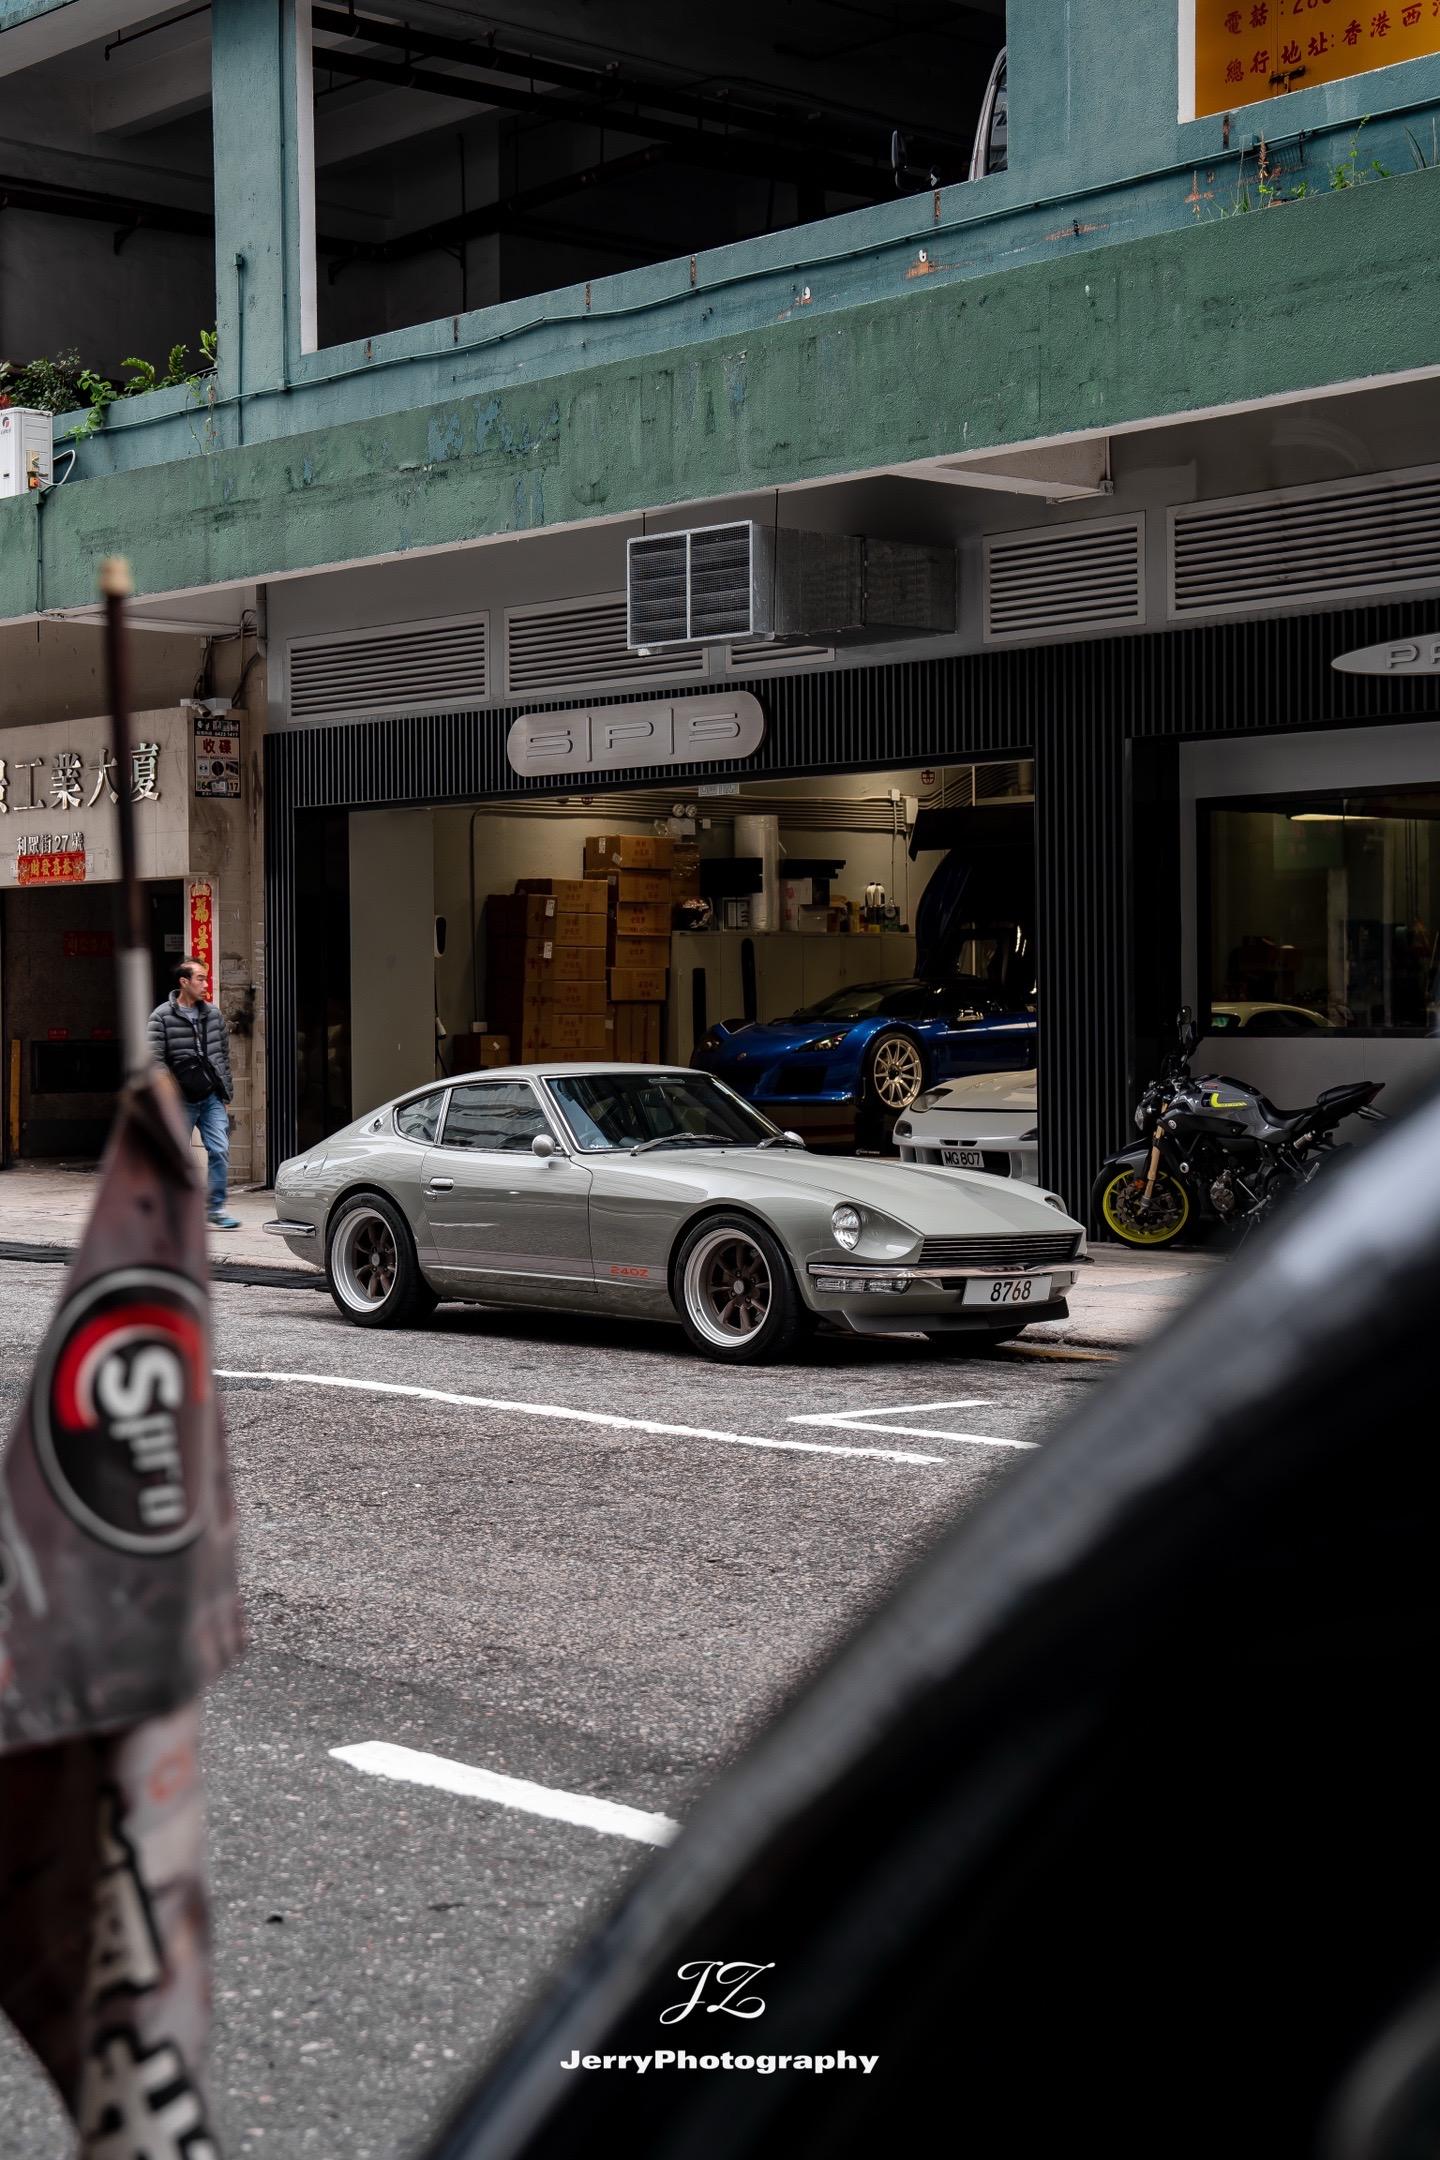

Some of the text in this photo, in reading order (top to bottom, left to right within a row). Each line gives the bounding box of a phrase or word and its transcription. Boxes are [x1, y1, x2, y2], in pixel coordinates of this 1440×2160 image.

[0, 742, 160, 814] 工業大廈
[990, 1280, 1032, 1302] 8768
